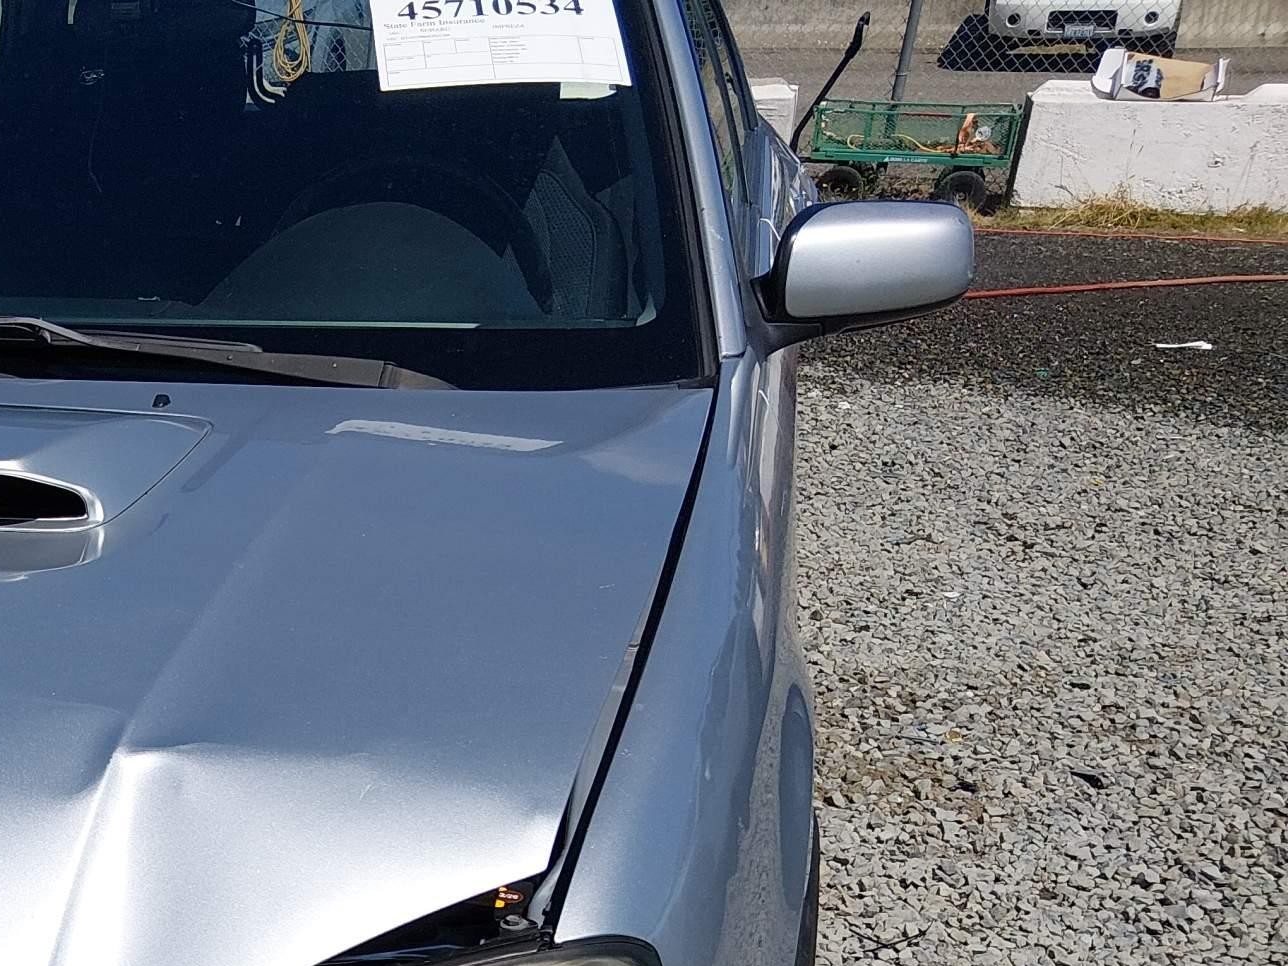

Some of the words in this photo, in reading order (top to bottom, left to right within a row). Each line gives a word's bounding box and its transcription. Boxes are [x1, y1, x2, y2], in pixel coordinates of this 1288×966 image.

[397, 0, 584, 20] 45710534
[383, 22, 408, 30] State
[410, 20, 436, 28] Farm
[439, 17, 486, 26] Insurance
